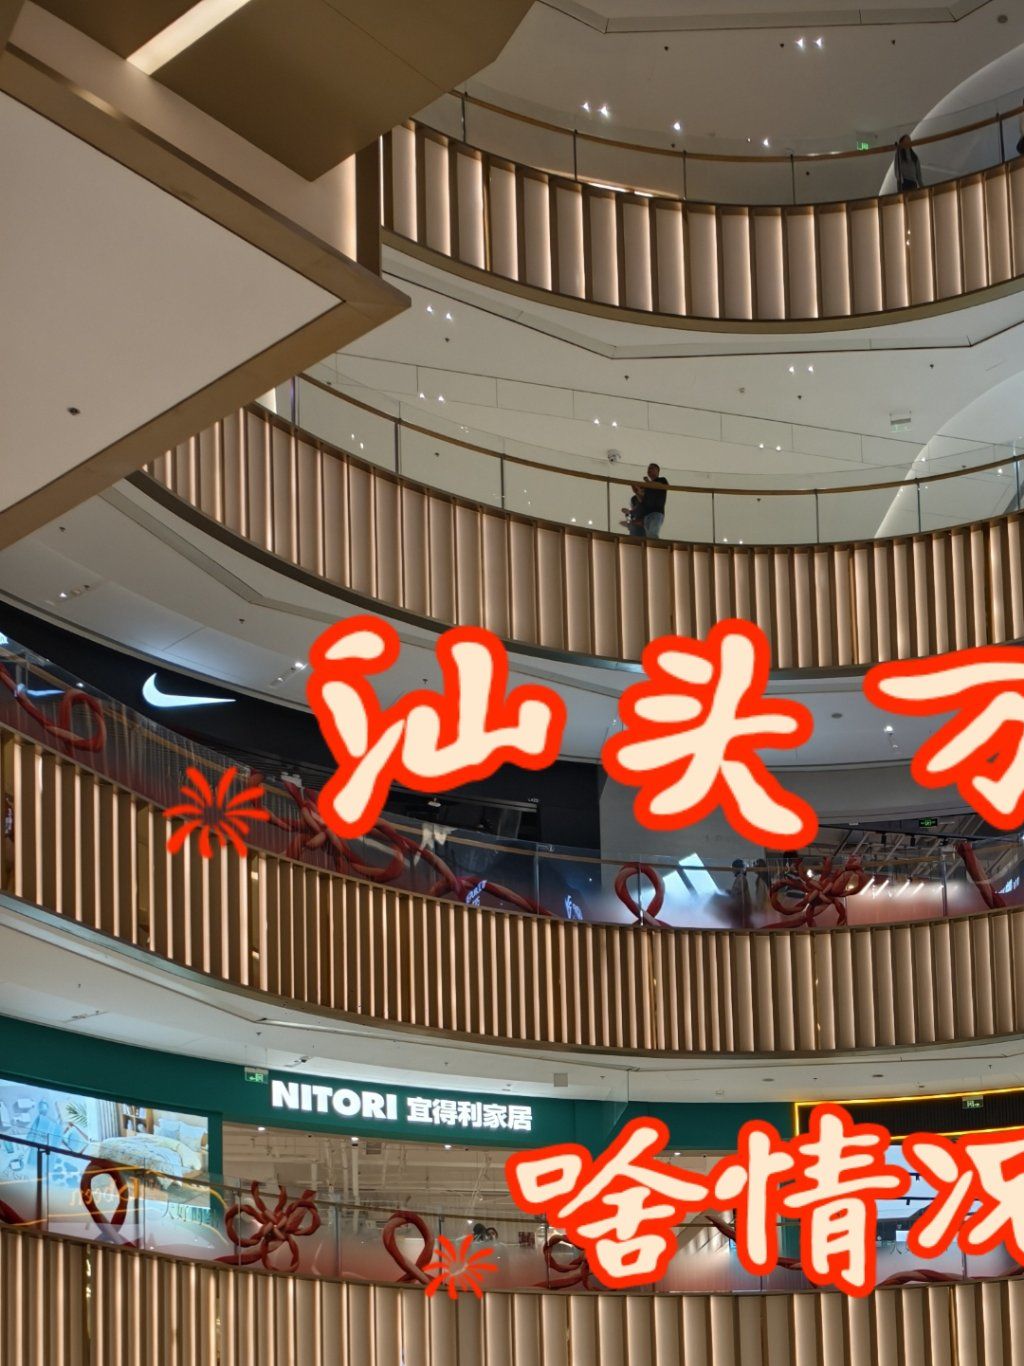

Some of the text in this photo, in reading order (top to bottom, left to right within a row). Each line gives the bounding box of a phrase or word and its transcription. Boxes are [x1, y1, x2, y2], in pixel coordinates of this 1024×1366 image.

[271, 1080, 533, 1131] NITORI 宜得利家居
